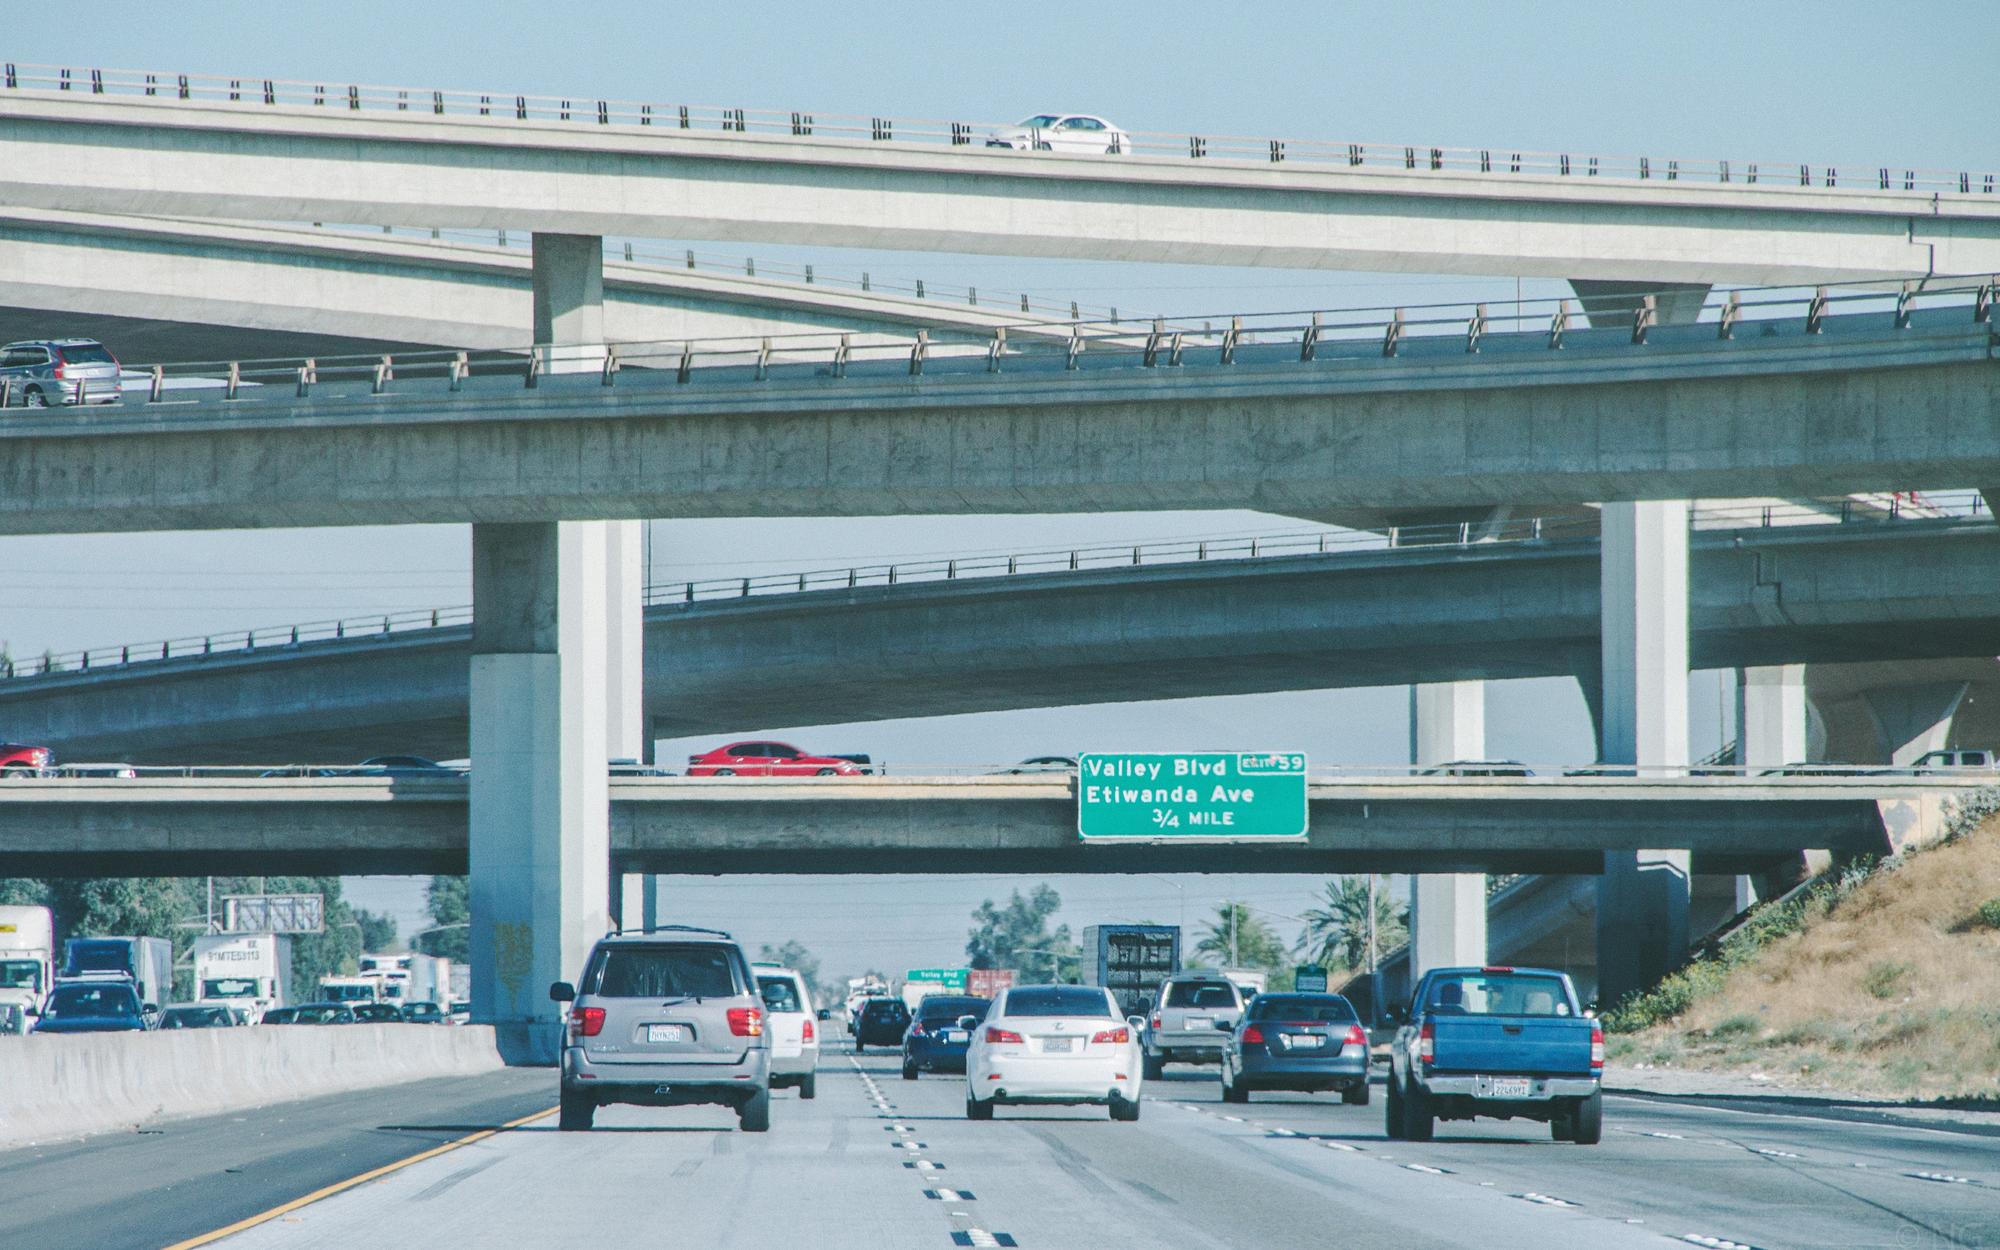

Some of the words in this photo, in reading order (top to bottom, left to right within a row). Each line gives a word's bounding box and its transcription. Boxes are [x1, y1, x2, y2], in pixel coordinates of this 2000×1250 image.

[1088, 759, 1161, 780] Valley
[1174, 759, 1226, 776] Blvd
[1278, 756, 1303, 770] 59
[1087, 786, 1198, 803] Etiwanda
[1211, 785, 1254, 802] Ave
[1189, 812, 1234, 825] MILE
